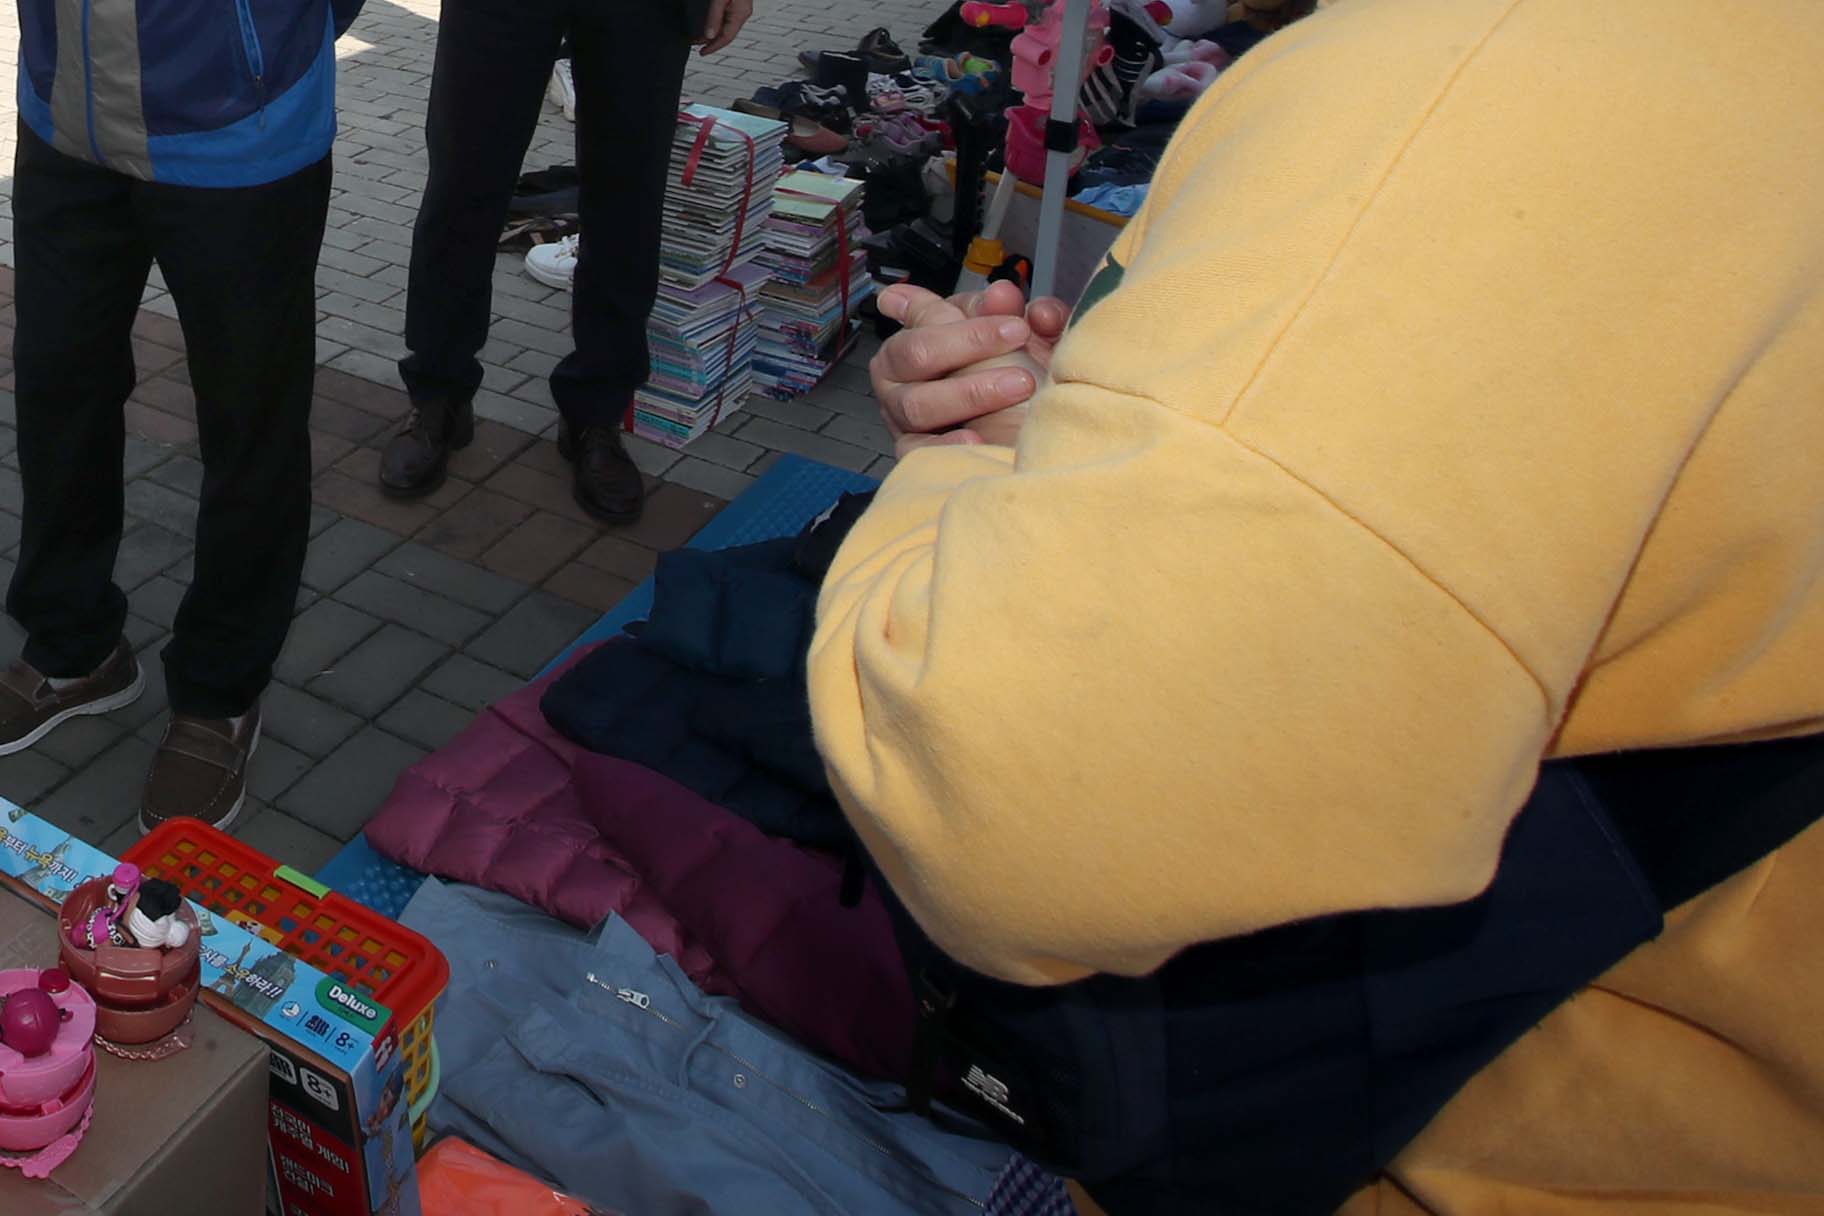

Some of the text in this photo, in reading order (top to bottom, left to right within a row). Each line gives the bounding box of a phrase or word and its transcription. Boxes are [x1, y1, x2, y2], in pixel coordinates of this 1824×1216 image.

[24, 844, 78, 883] 뉴욕까지!
[328, 984, 377, 1019] Deluxe
[336, 1032, 354, 1048] 8+
